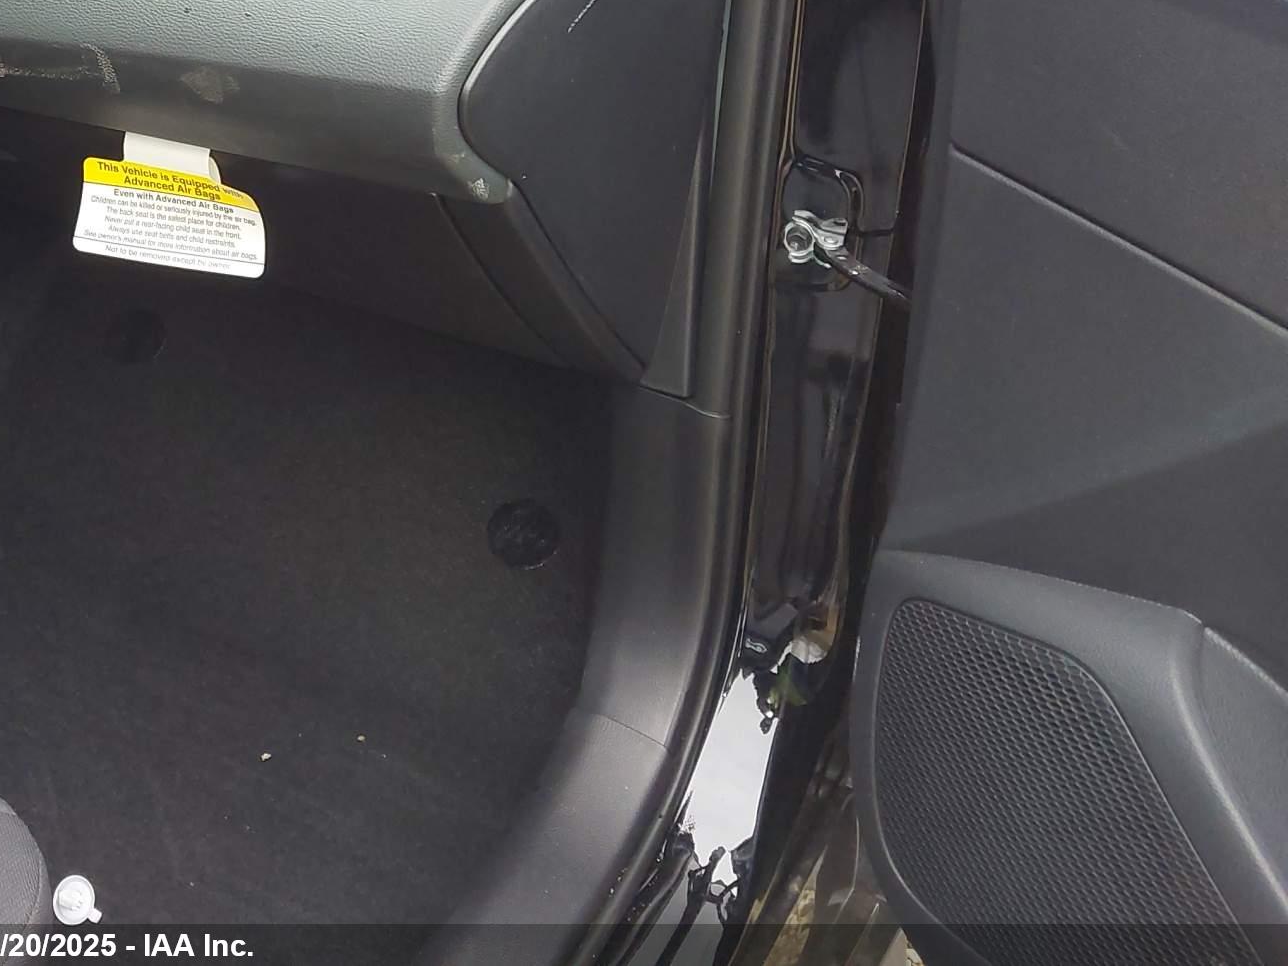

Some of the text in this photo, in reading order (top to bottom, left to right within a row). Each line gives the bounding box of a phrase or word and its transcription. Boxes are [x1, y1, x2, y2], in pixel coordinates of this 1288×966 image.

[97, 161, 119, 173] This
[122, 165, 158, 179] Vehicle
[160, 172, 170, 181] is
[172, 175, 220, 191] Equipped
[124, 176, 221, 200] Advanced Air Bags
[91, 195, 116, 204] Children
[130, 199, 138, 207] be
[139, 200, 155, 209] killed
[164, 205, 191, 215] seriously
[192, 209, 213, 218] injured
[214, 212, 221, 220] by
[107, 205, 118, 214] The
[135, 210, 149, 218] seat
[114, 188, 234, 214] Even with Advanced Air Bags
